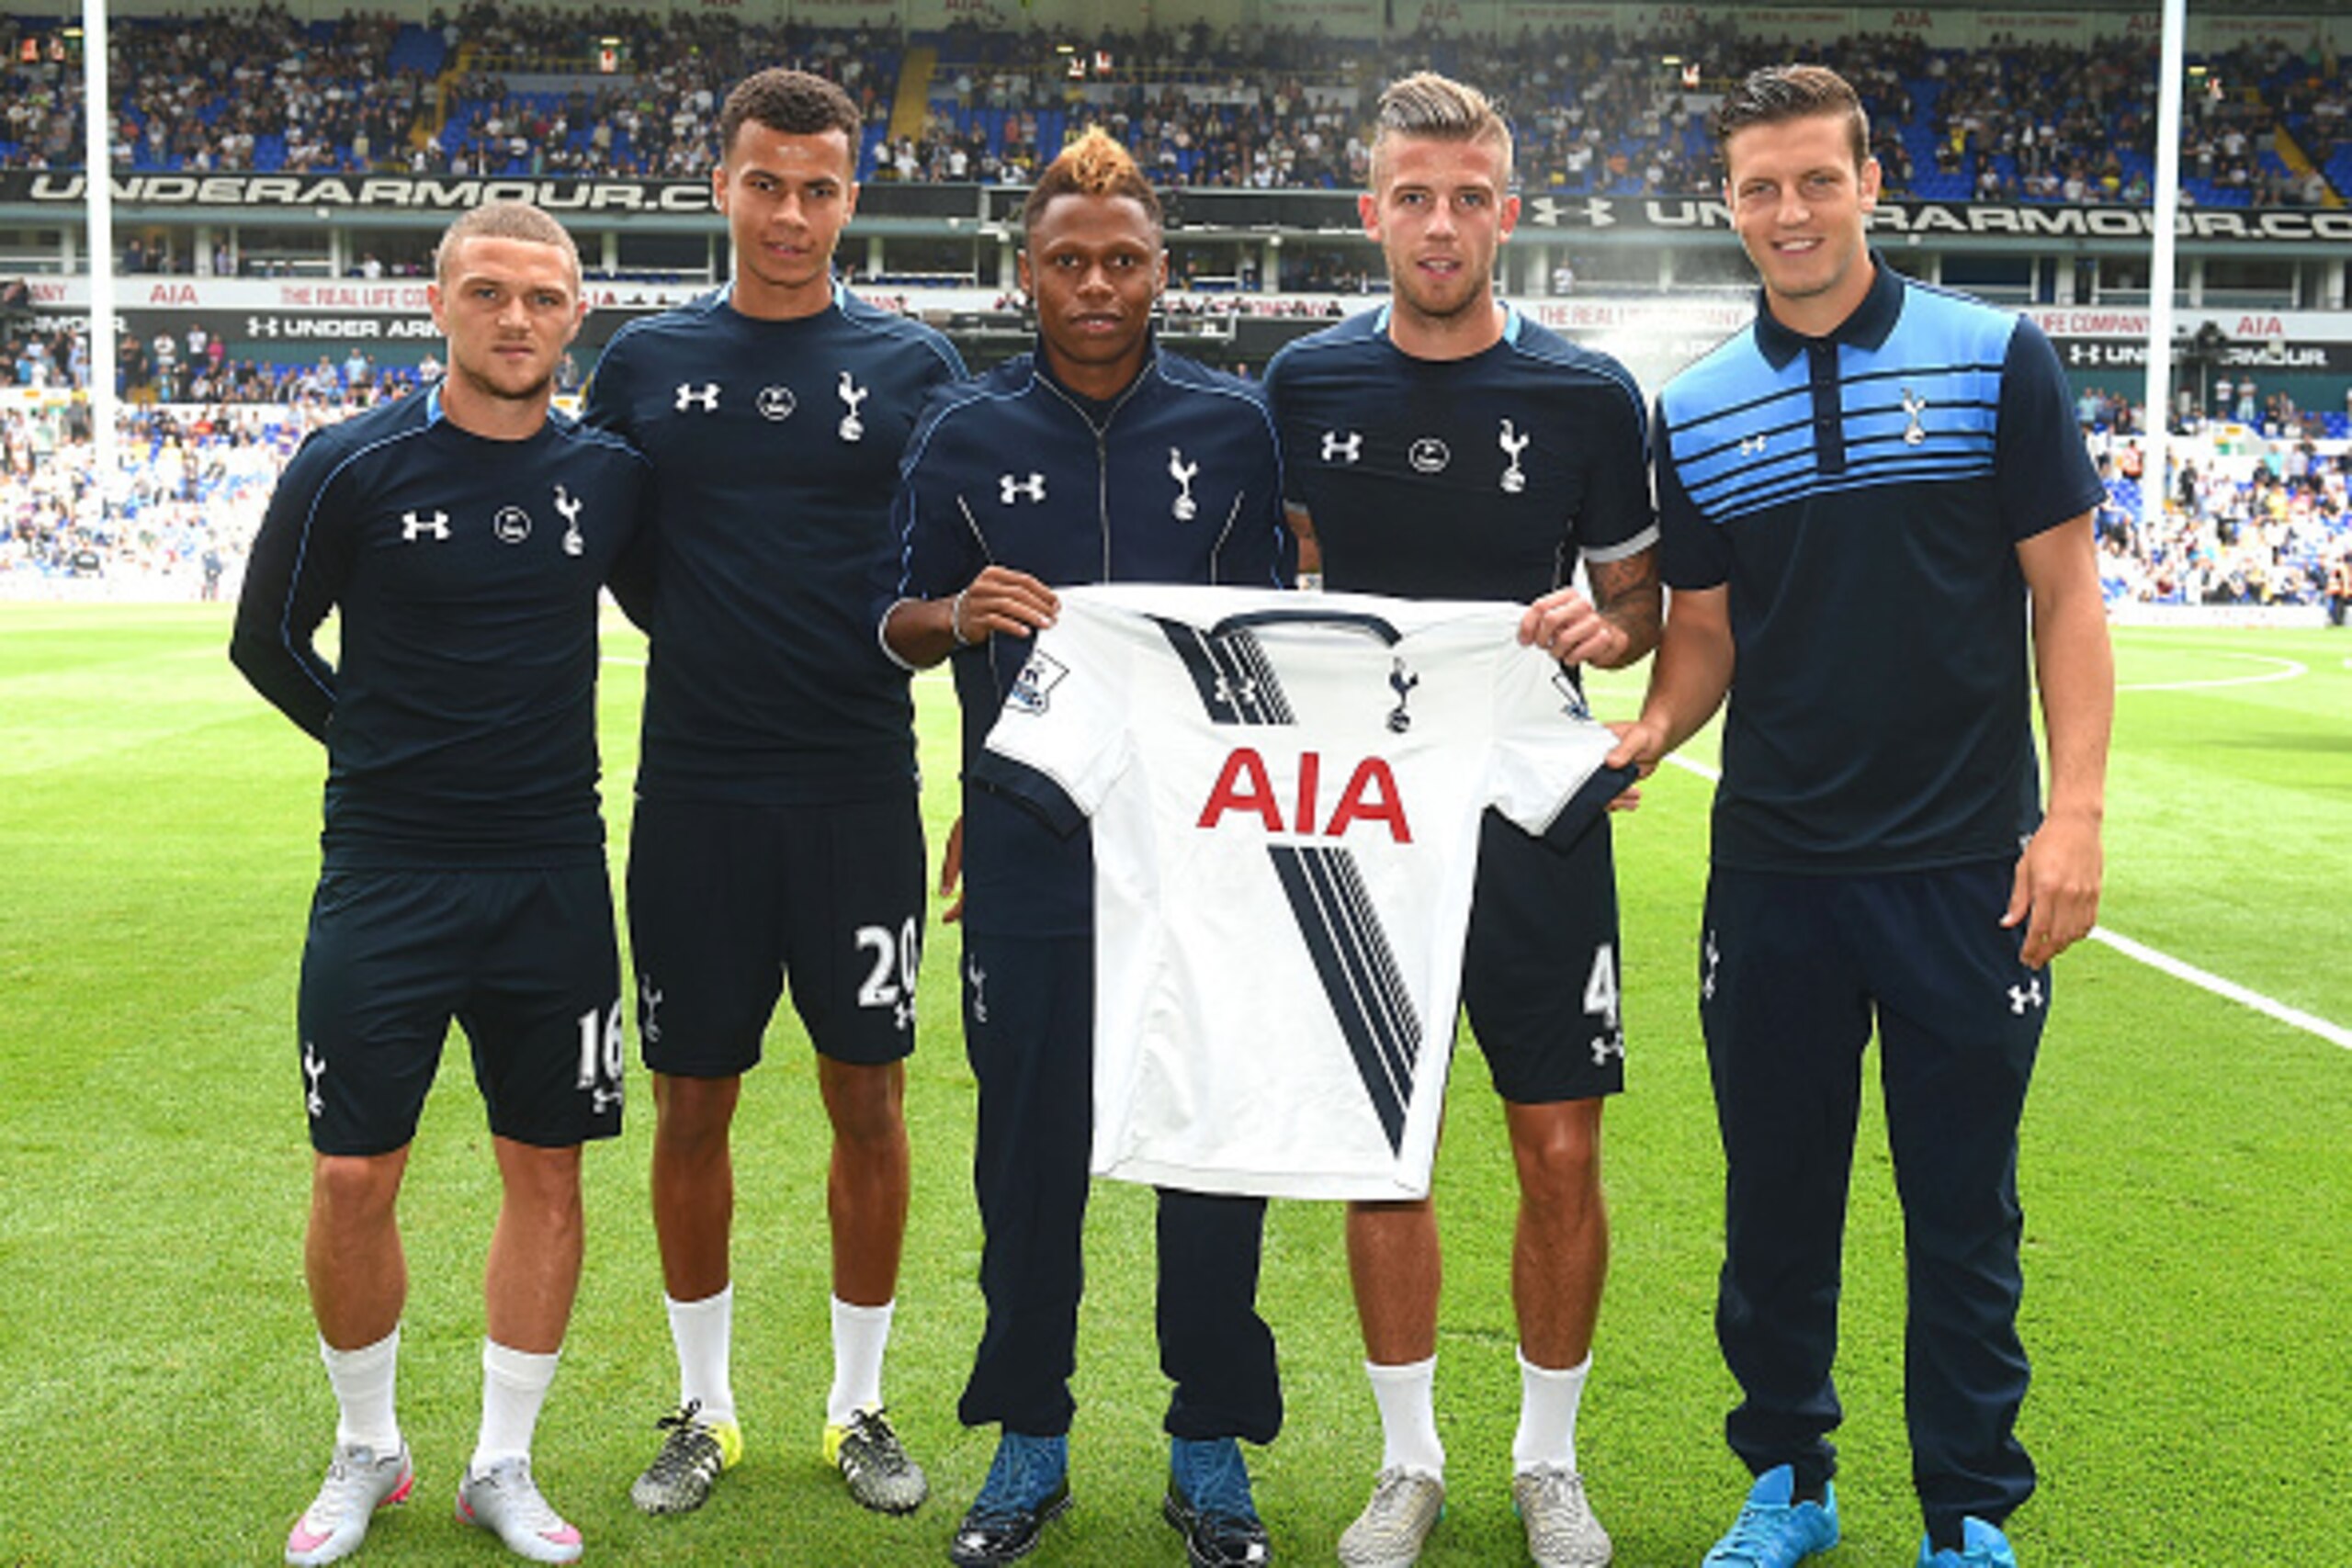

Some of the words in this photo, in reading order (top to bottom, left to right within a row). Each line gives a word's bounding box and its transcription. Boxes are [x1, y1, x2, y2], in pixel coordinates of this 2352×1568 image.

[1893, 11, 1932, 28] AIA
[30, 176, 710, 209] UNDERARMOUR.C
[150, 284, 198, 305] AIA
[282, 287, 311, 305] THE
[1539, 305, 1567, 324] THE
[284, 319, 379, 337] UNDER
[387, 320, 445, 337] ARM
[2237, 316, 2283, 335] AIA
[1196, 747, 1413, 844] AIA
[854, 916, 918, 1007] 20
[1584, 942, 1617, 1030] 4
[576, 998, 623, 1089] 16
